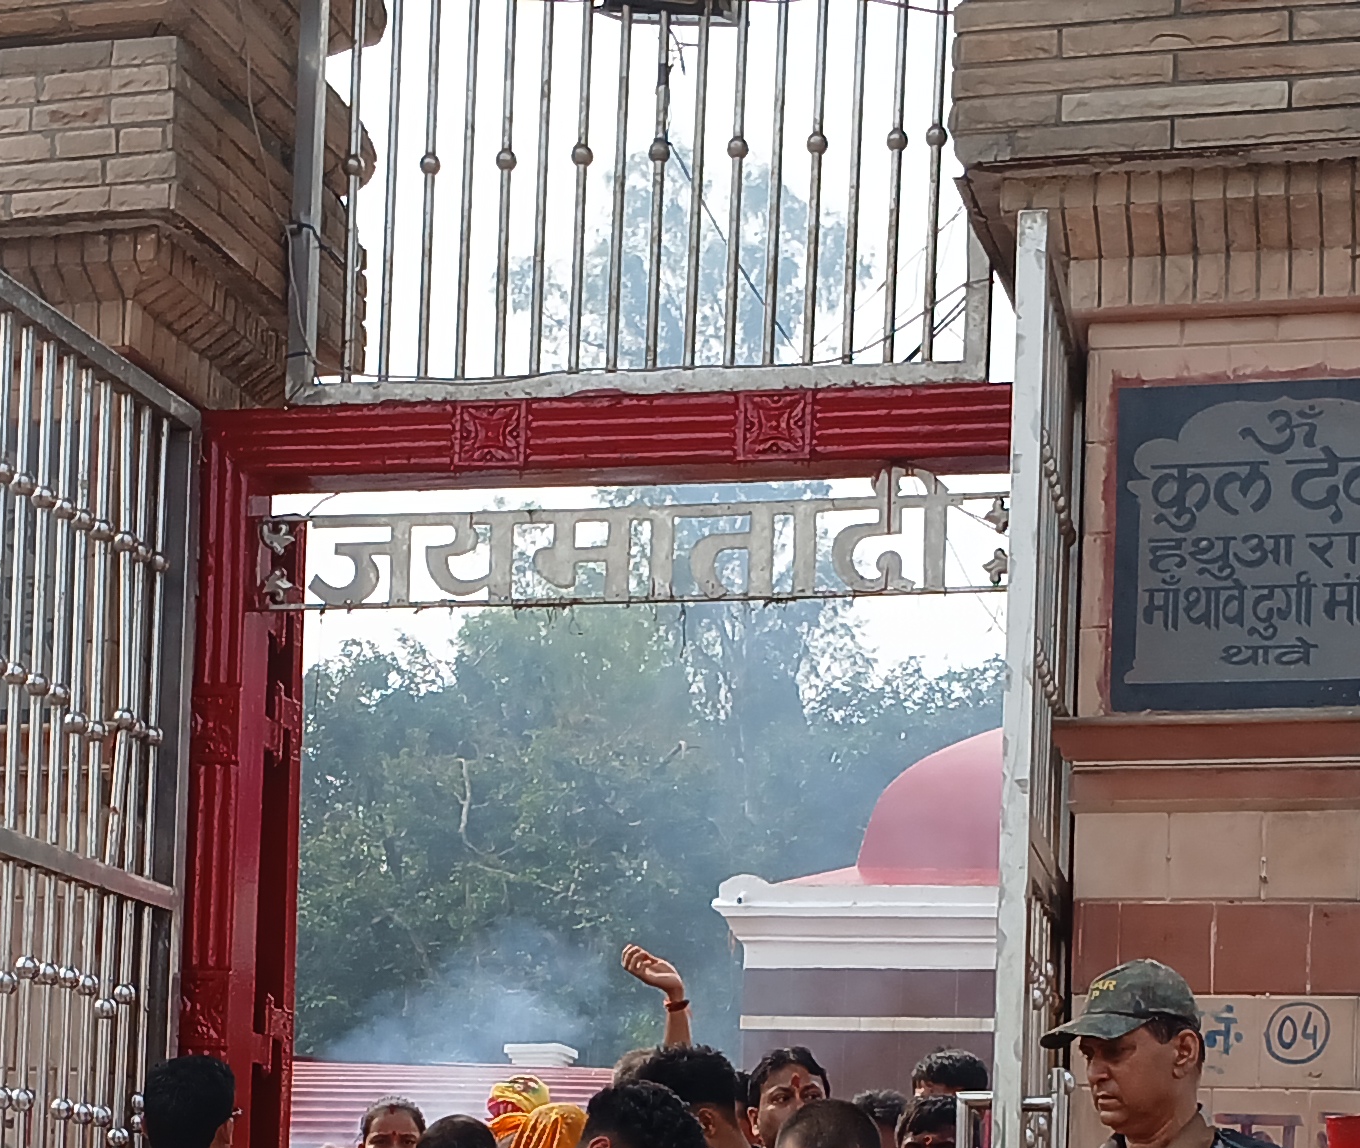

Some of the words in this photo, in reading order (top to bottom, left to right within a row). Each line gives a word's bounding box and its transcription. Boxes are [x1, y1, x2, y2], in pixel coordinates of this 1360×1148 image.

[1150, 460, 1272, 533] कुल
[1147, 533, 1296, 581] हथुआ
[1220, 636, 1319, 666] थावे
[1277, 1010, 1318, 1050] 04
